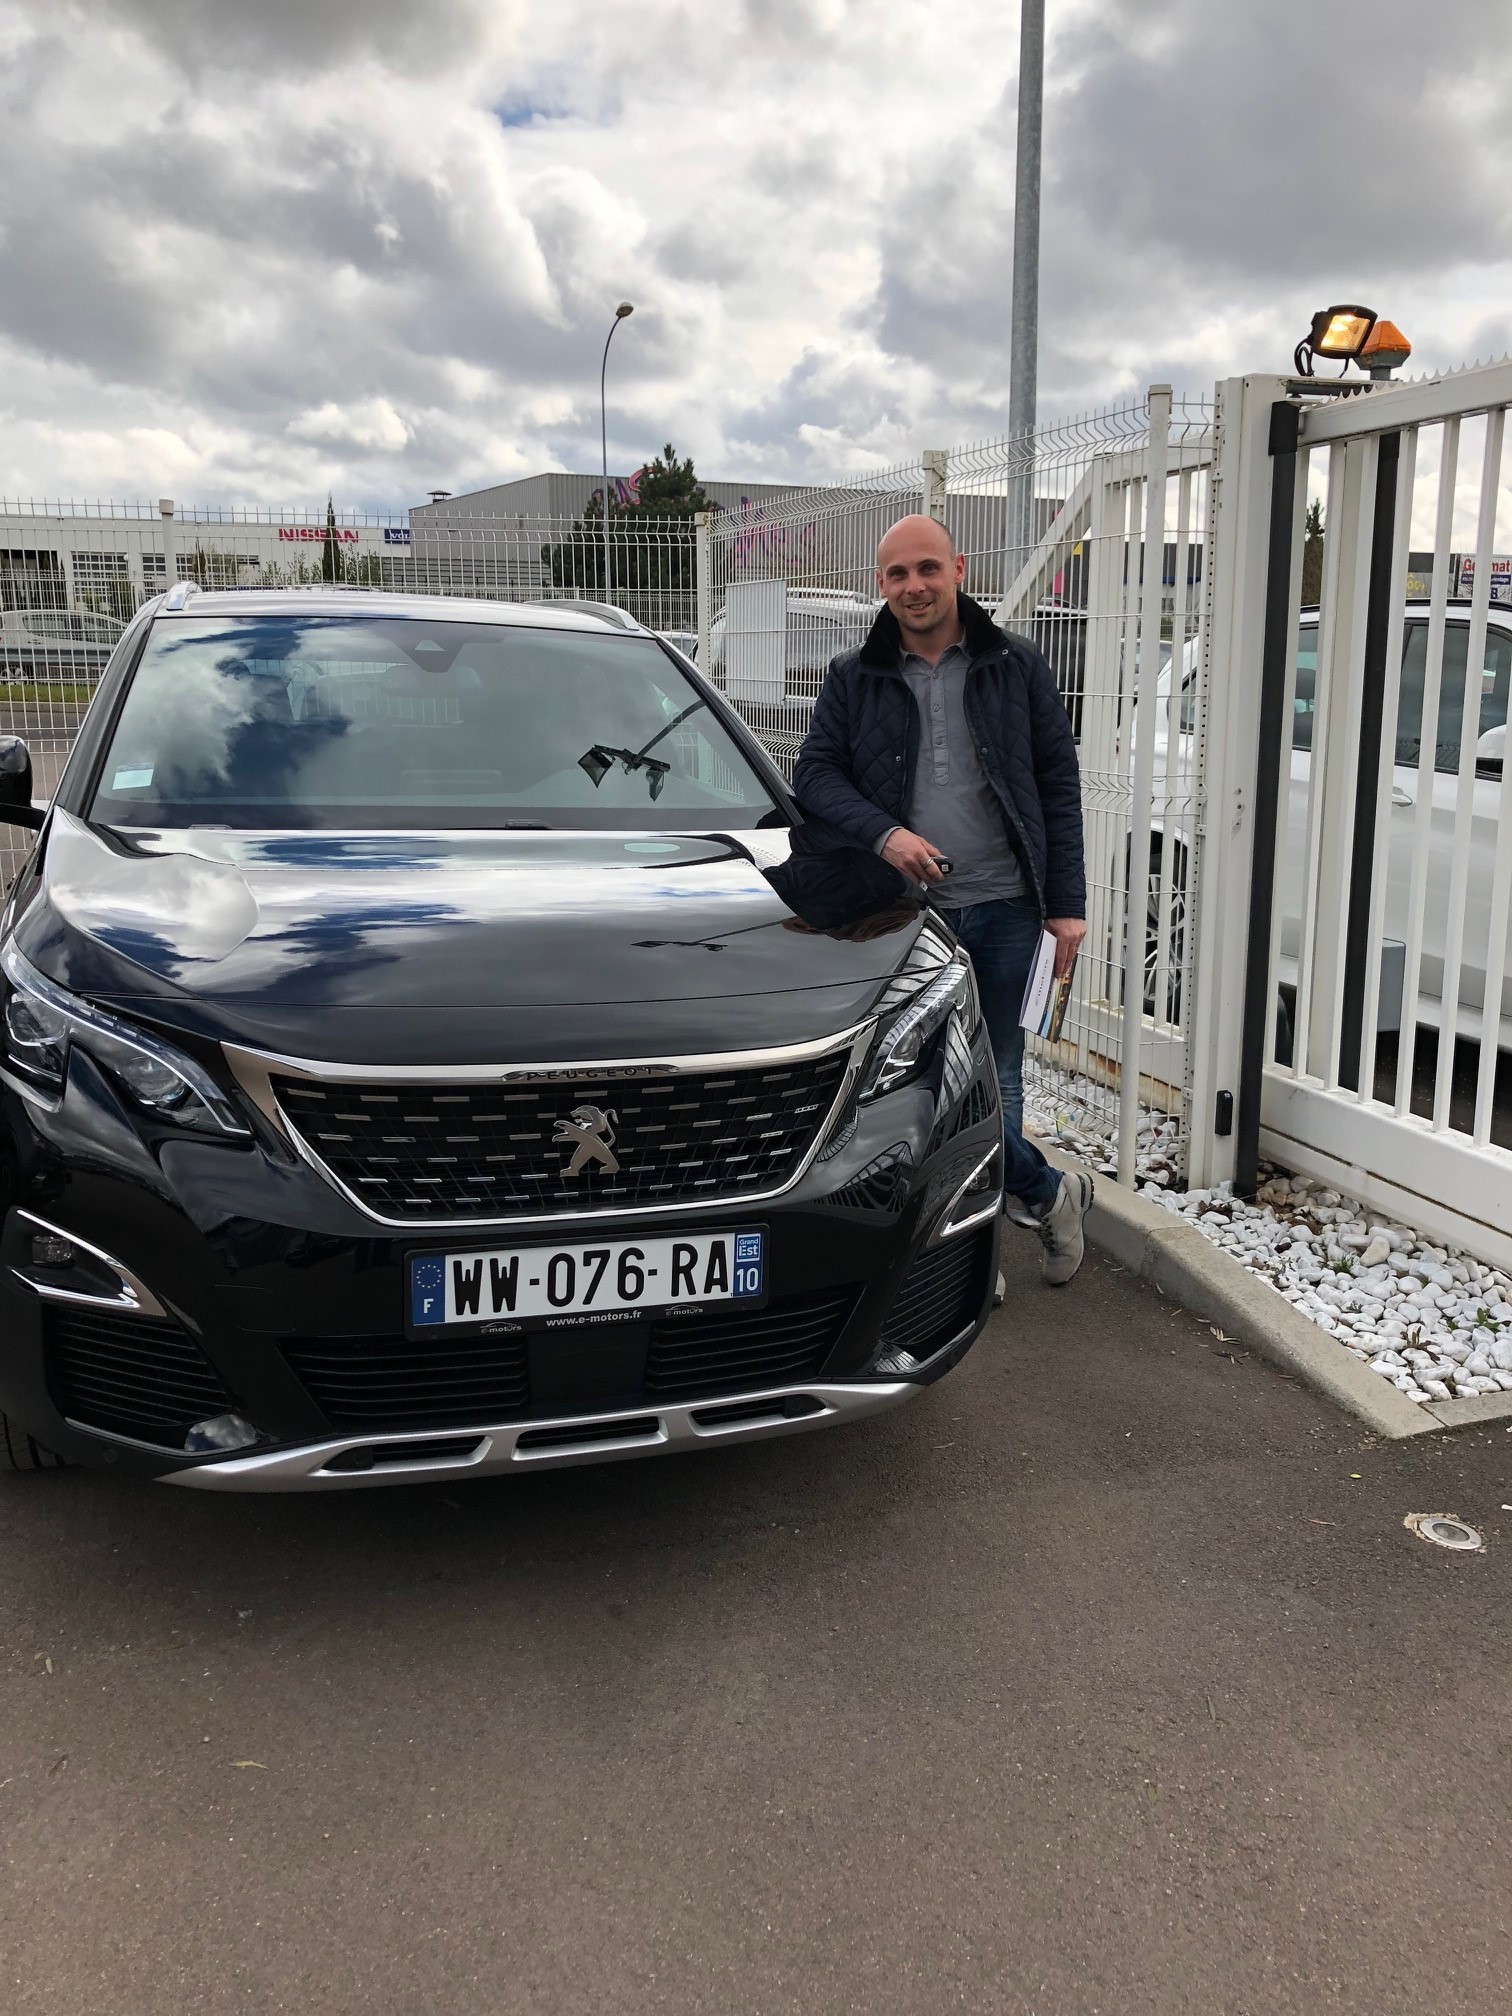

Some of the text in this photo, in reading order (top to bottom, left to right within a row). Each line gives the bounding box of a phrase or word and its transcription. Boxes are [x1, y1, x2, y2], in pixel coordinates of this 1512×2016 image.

[526, 1066, 656, 1081] PEUGEOT
[739, 1238, 759, 1246] Grand
[738, 1245, 758, 1256] Est
[453, 1240, 729, 1316] WW-076-RA
[736, 1267, 759, 1292] 10
[423, 1298, 434, 1313] F
[546, 1310, 642, 1328] www.e-motors.fr
